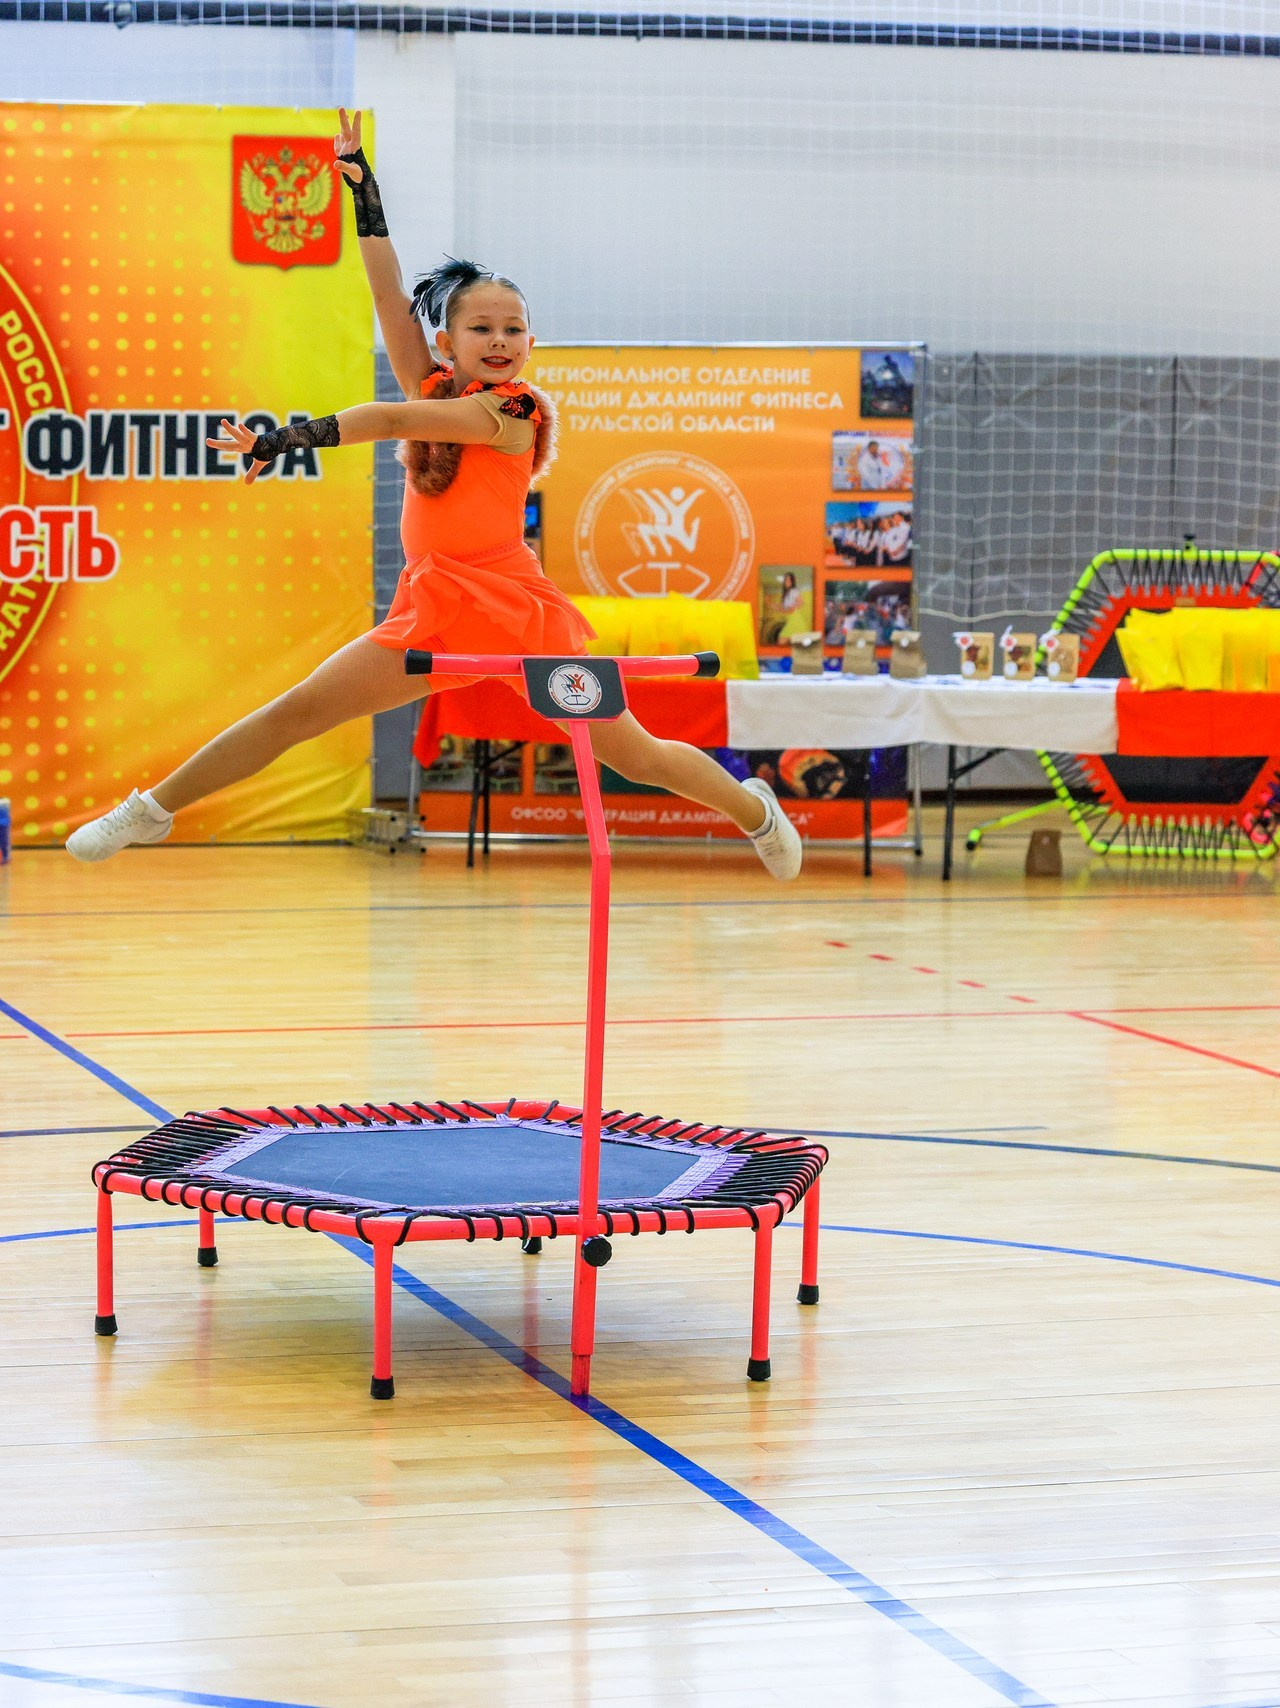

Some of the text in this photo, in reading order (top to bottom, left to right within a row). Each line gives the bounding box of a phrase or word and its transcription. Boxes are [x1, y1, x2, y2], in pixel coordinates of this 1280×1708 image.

[535, 366, 811, 387] РЕГИОНАЛЬНОЕ ОТДЕЛЕНИЕ
[549, 389, 844, 411] РАЦИИ ДЖАМПИНГ ФИТНЕСА
[569, 411, 776, 434] ТУЛЬСКОЙ ОБЛАСТИ
